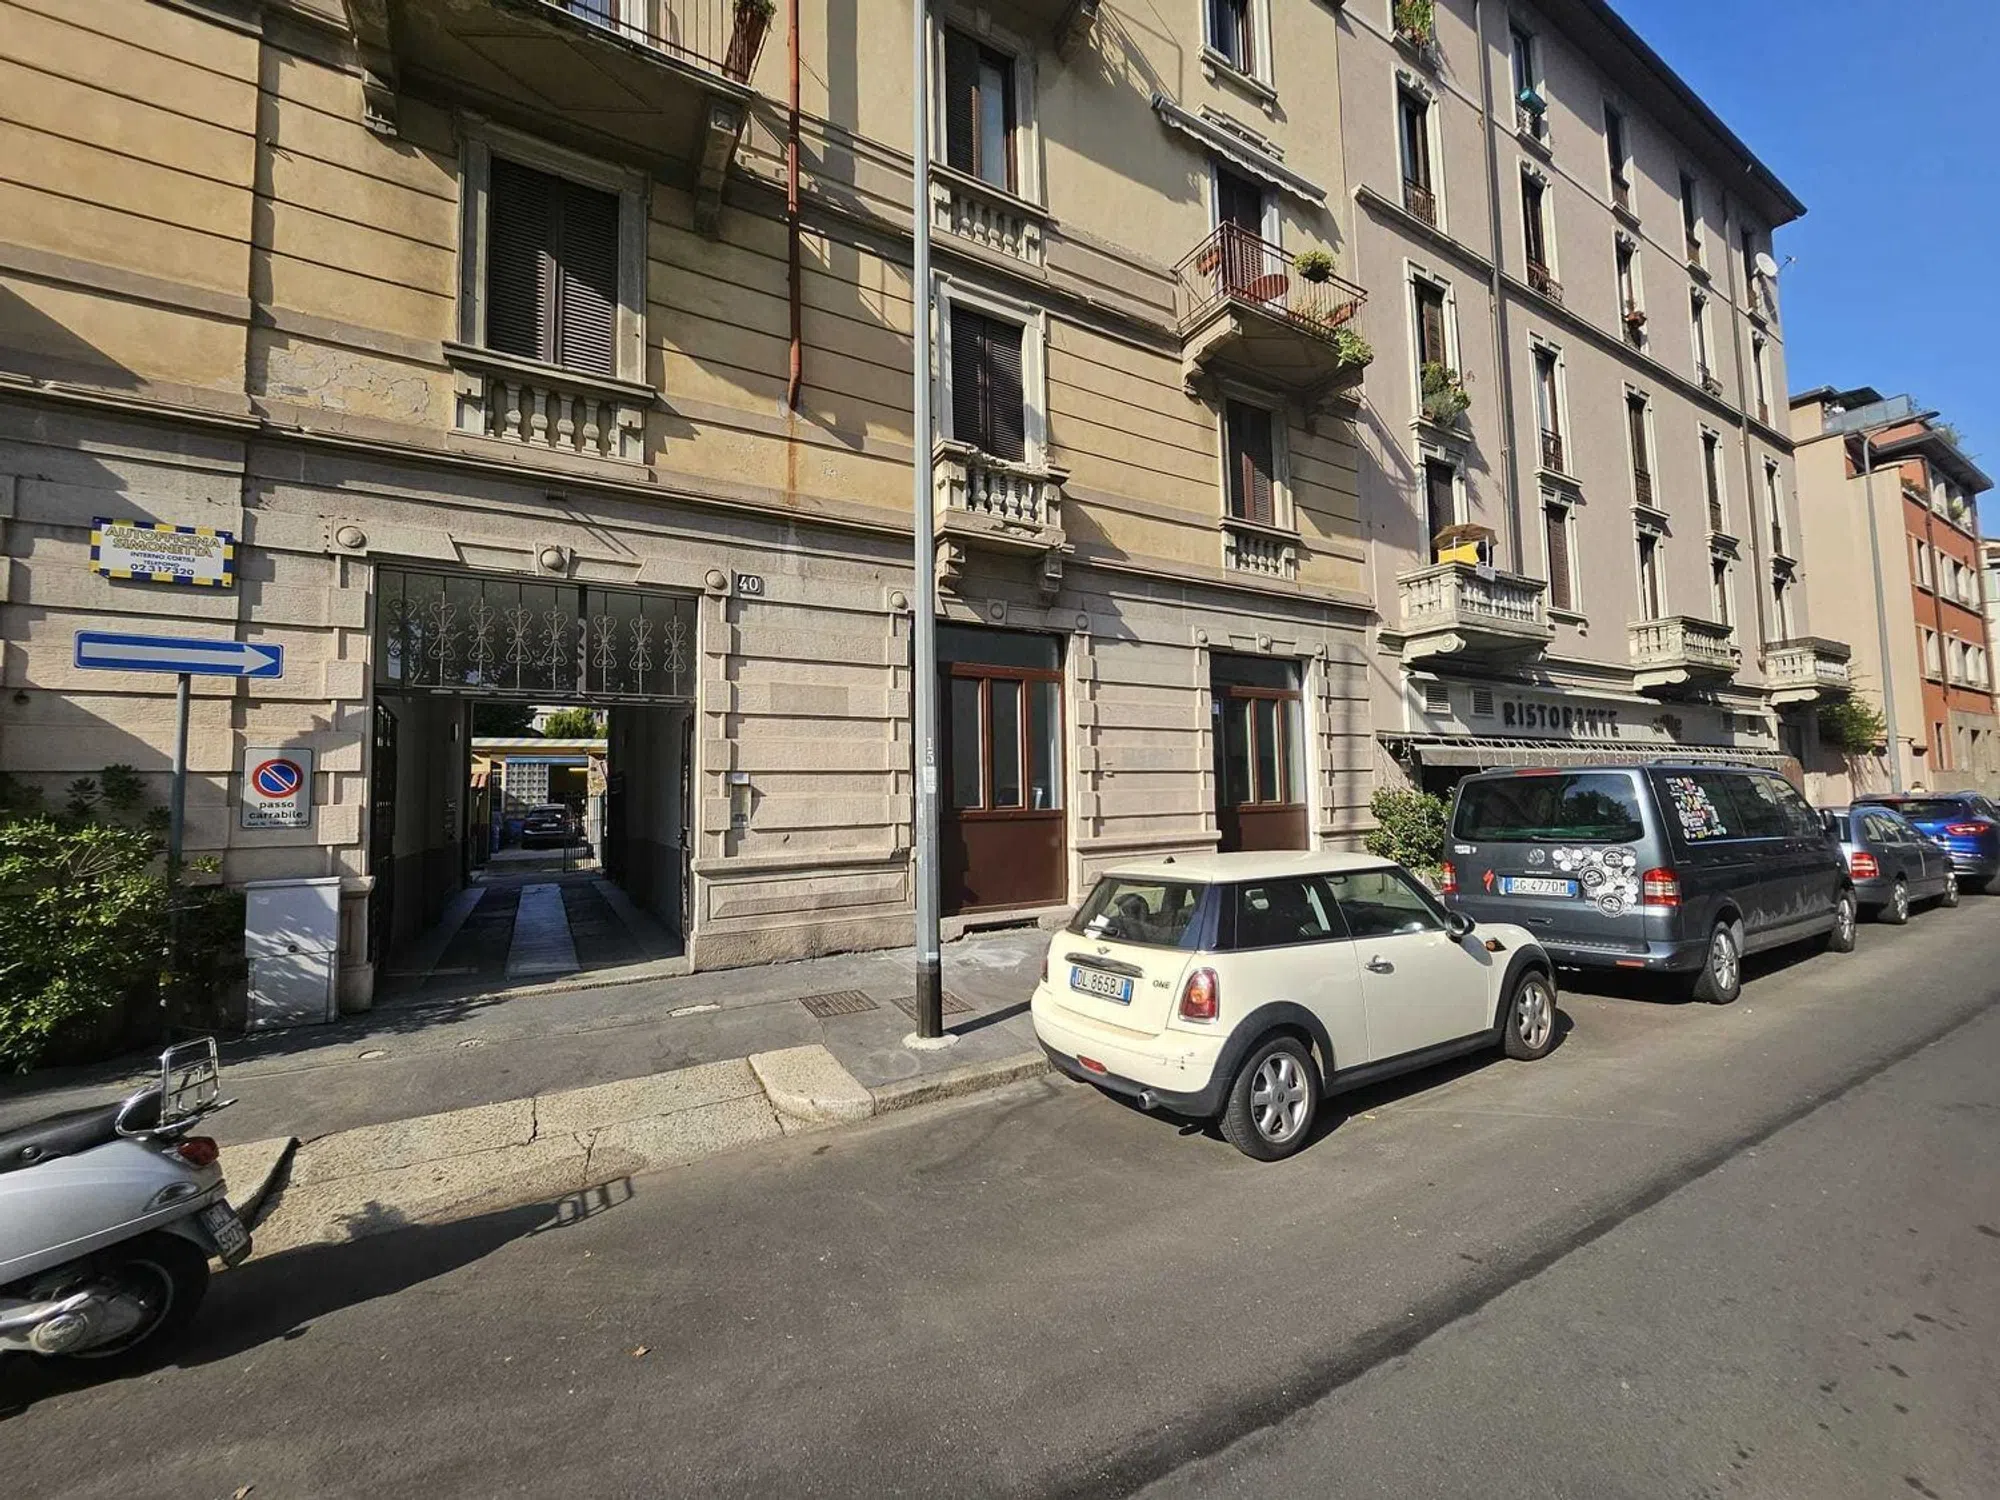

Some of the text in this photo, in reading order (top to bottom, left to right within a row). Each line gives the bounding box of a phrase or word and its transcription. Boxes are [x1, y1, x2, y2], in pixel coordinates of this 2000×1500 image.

[105, 526, 221, 548] AUTOFFICINA
[112, 538, 213, 558] SIMONETTA
[738, 576, 759, 591] 40
[1503, 695, 1620, 738] RISTORANTE
[249, 811, 303, 819] carrabile
